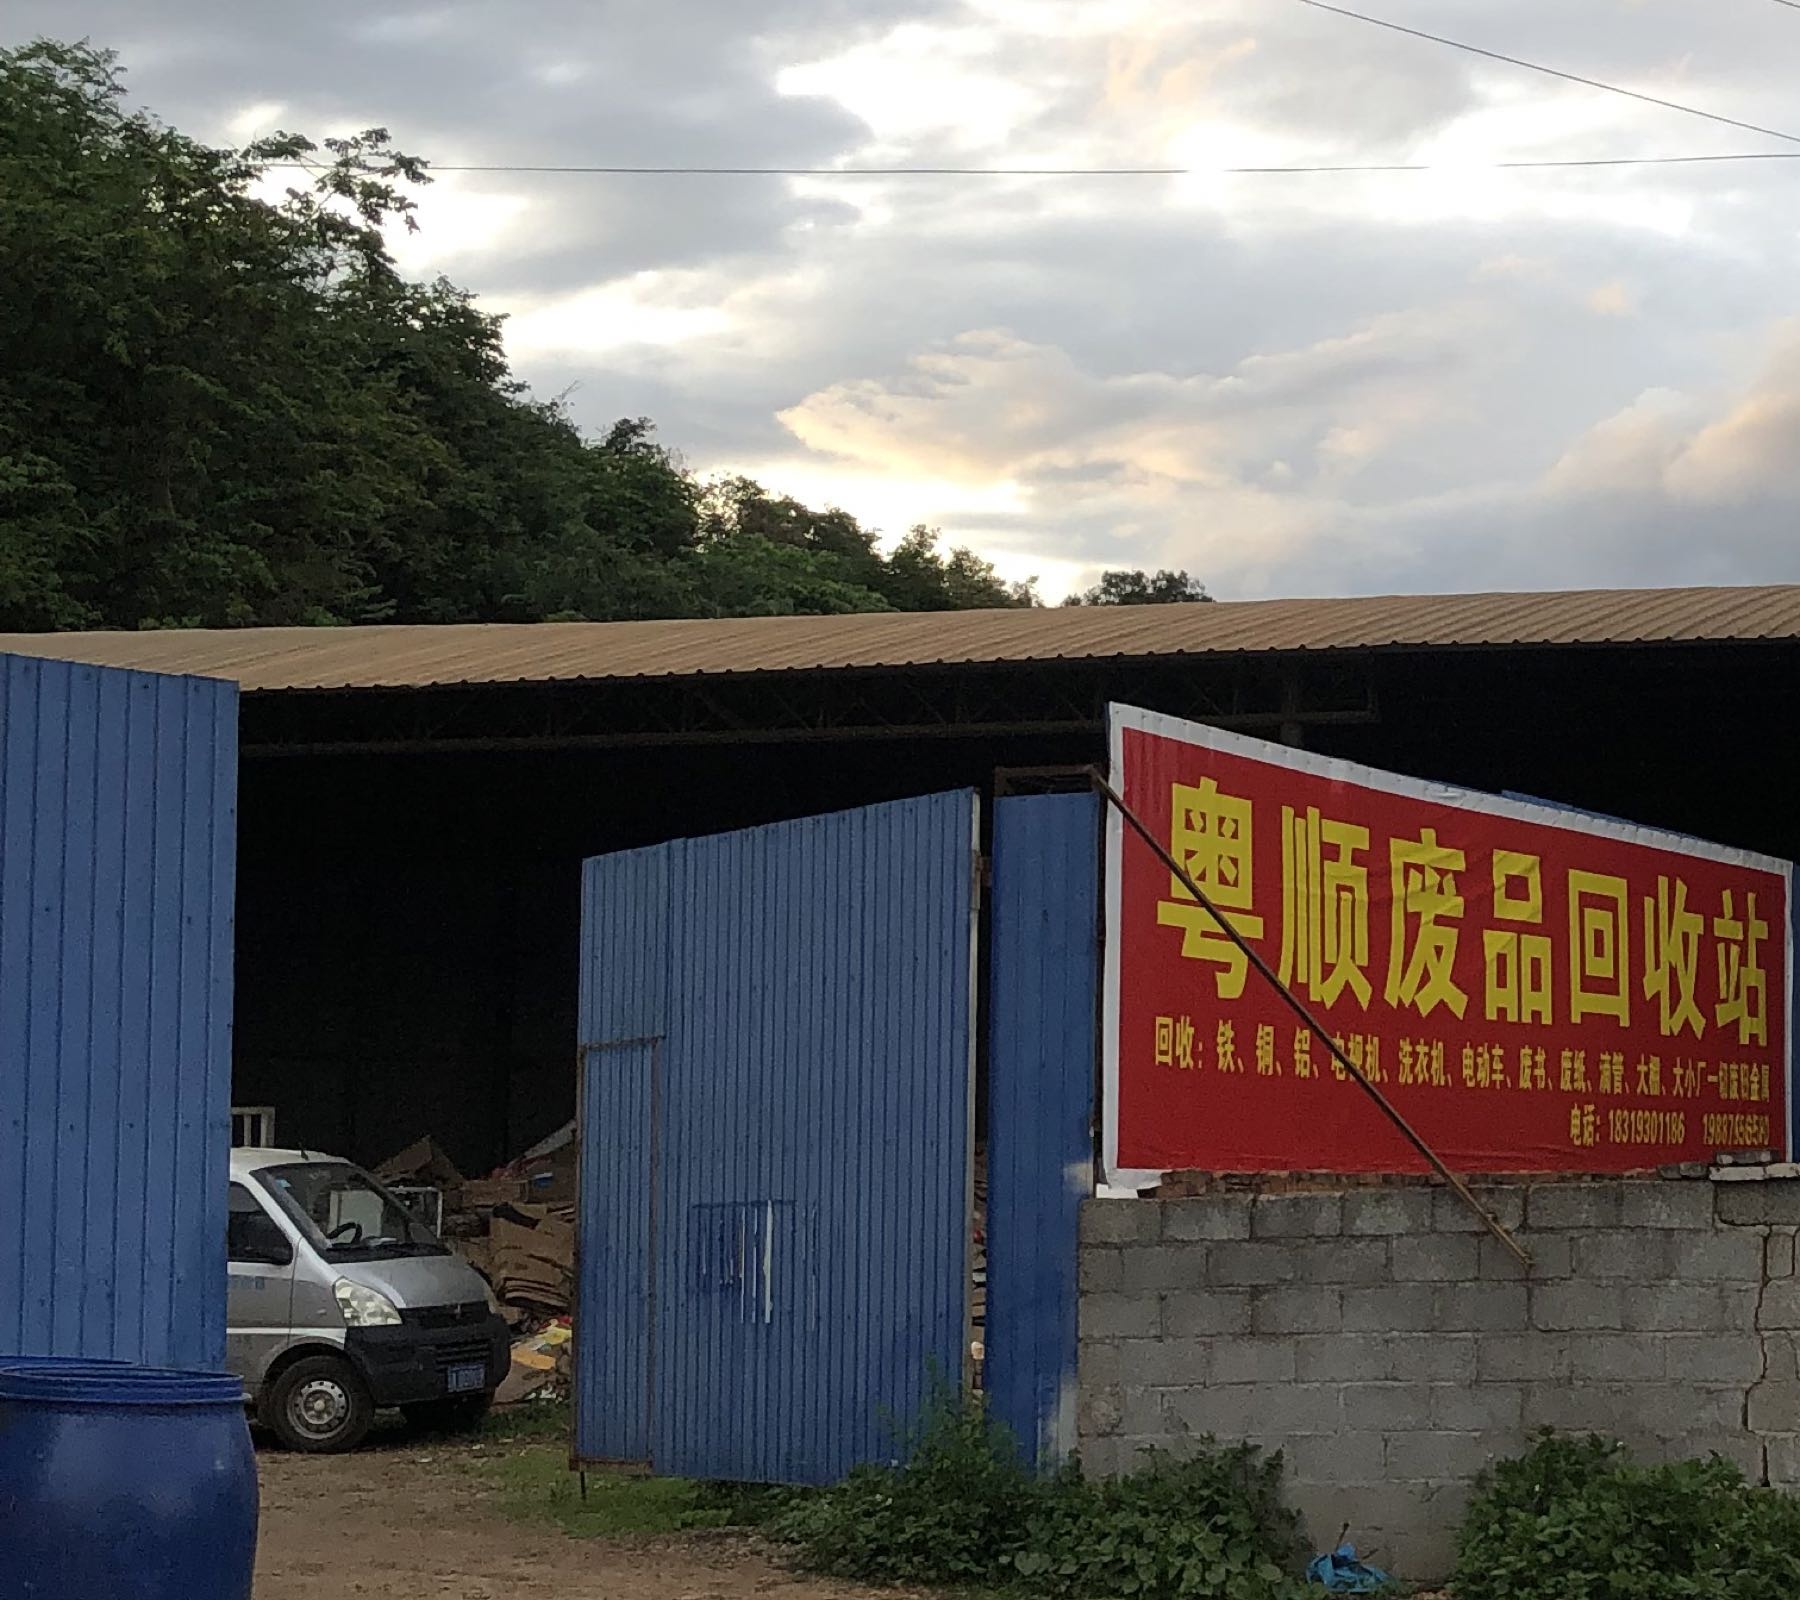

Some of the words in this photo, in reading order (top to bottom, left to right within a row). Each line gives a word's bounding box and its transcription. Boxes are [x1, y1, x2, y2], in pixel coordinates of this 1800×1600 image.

[1156, 775, 1770, 1048] 粤顺废品回收站
[1608, 1109, 1685, 1144] 18319301186
